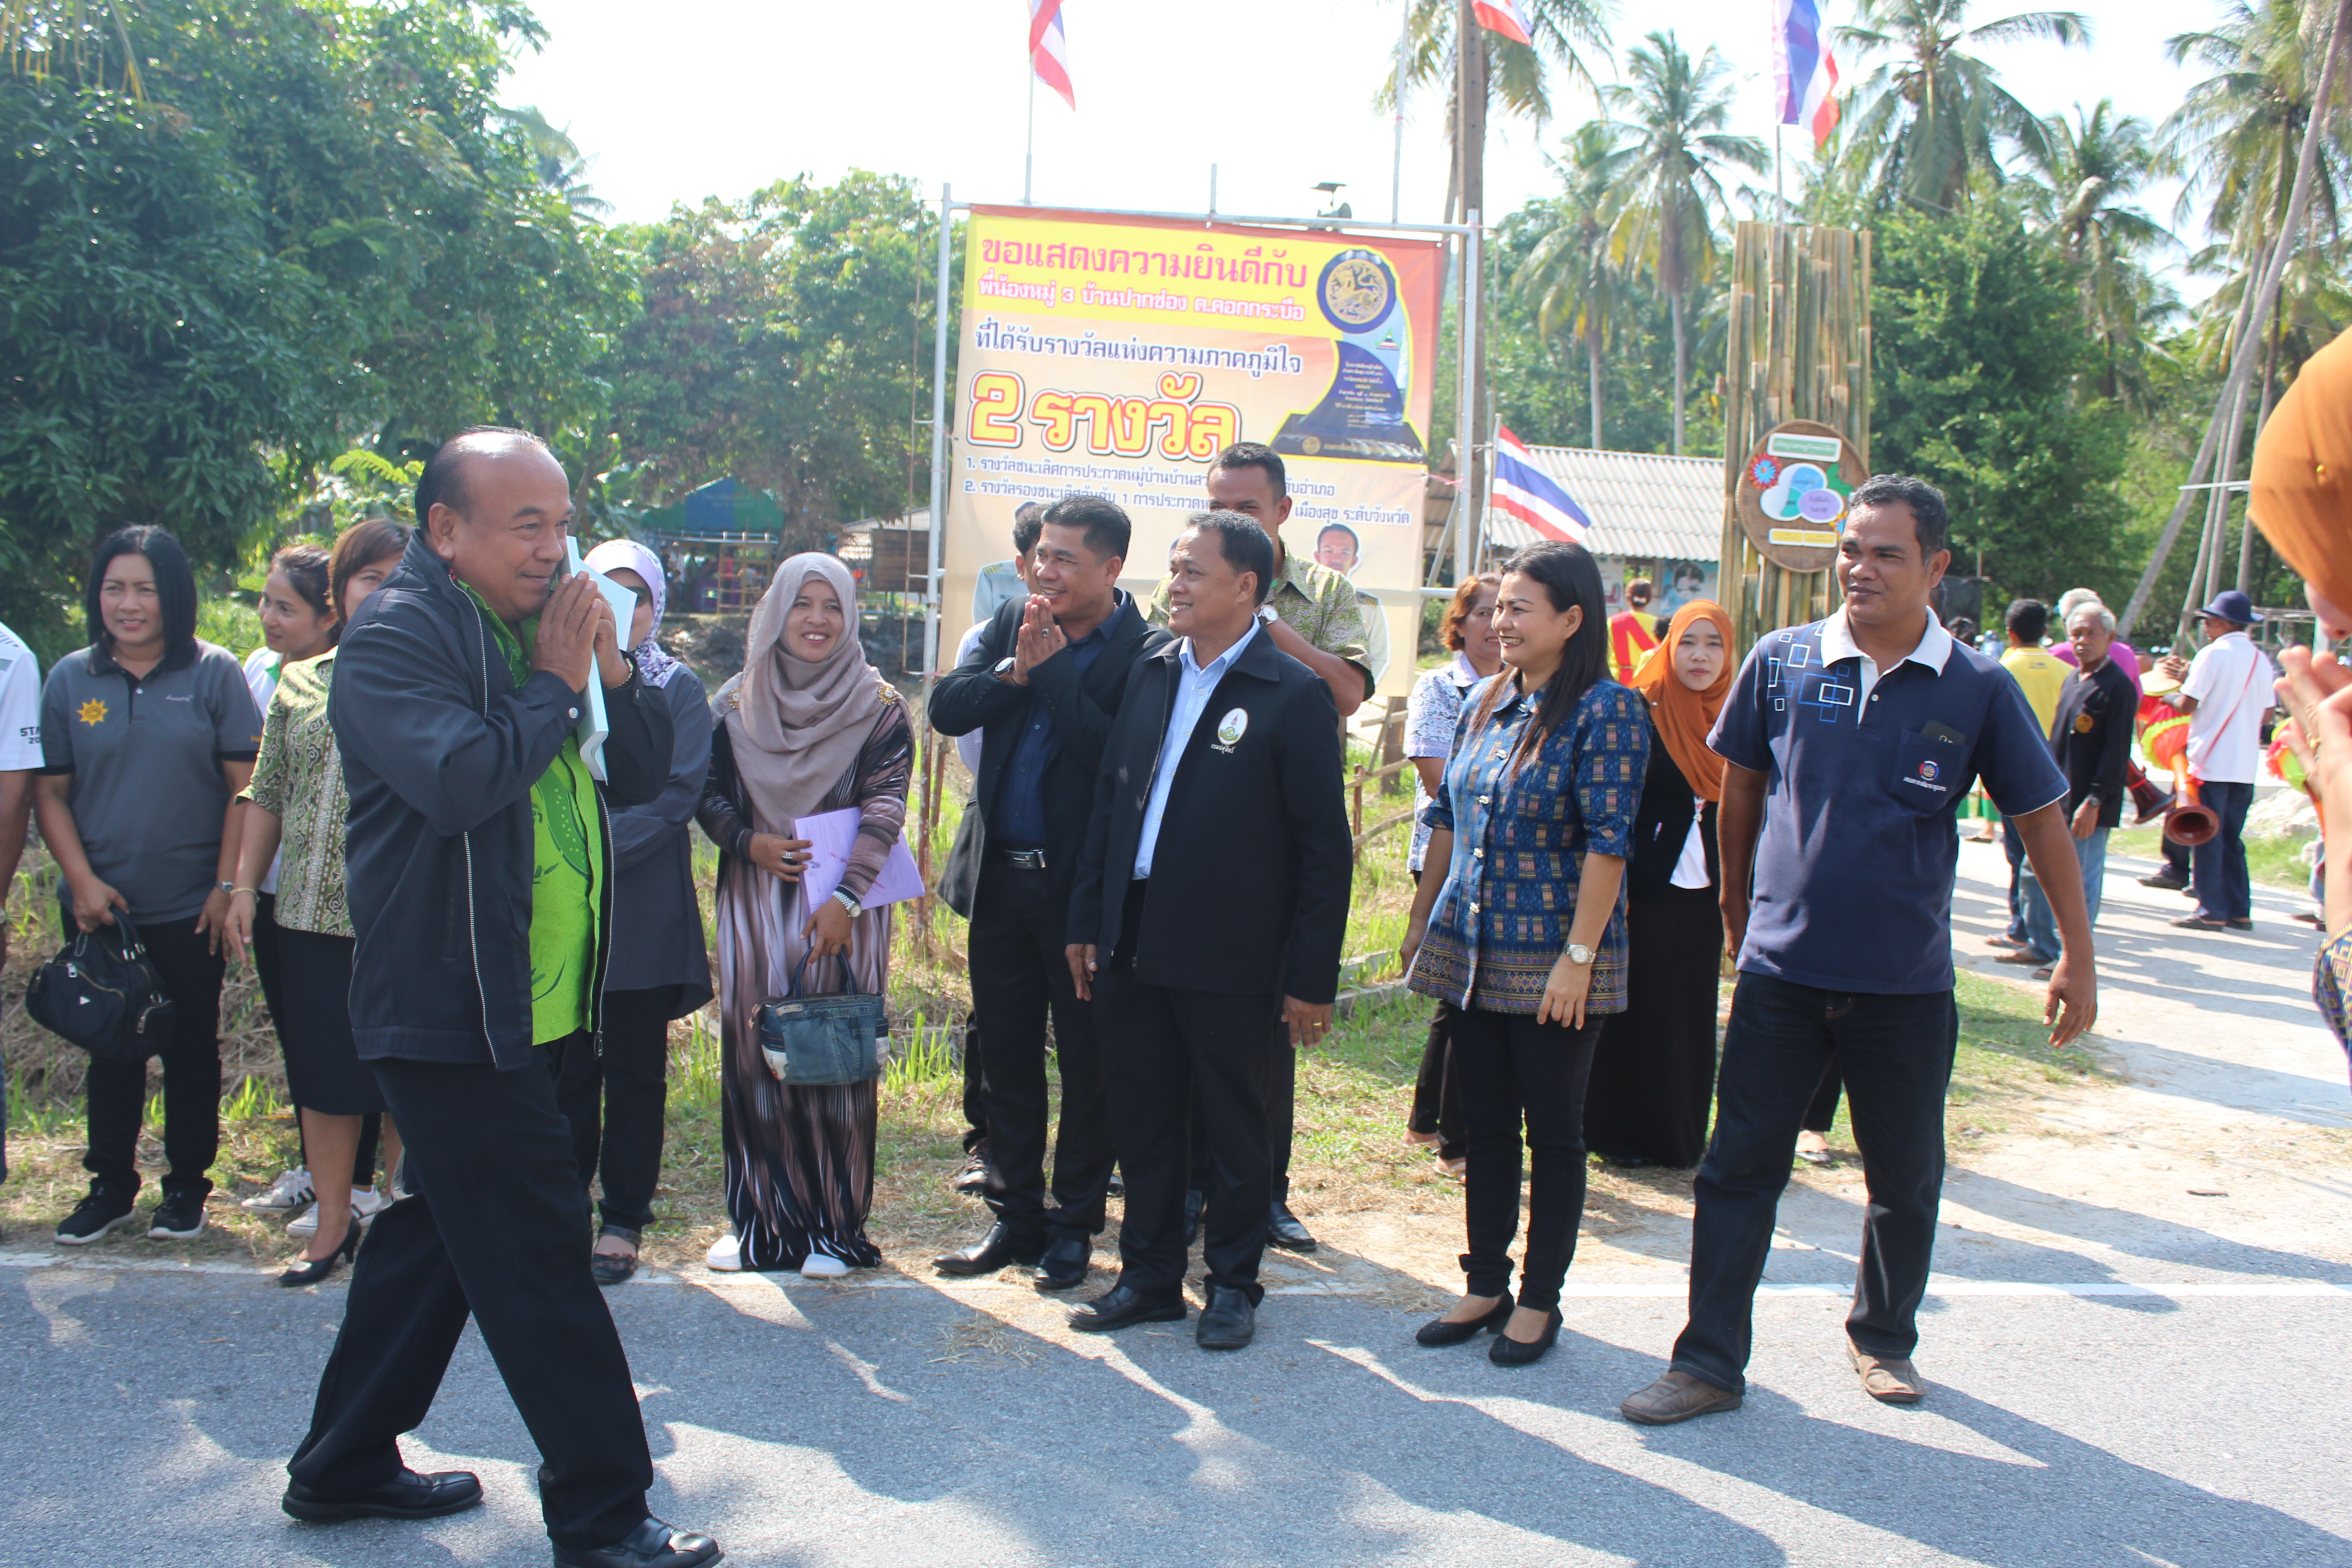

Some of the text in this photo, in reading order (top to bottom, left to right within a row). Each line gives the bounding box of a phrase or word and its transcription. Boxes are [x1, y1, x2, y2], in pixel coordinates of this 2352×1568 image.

[982, 239, 1307, 288] ขอแสดงความยินดีกับ
[978, 268, 1305, 321] พี่น้องหมู่ 3 บ้านปากช่อง ต.คอกกระบือ
[975, 317, 1301, 377] ที่ได้รับรางวัลแห่งความภาคภูมิใจ
[967, 370, 1241, 462] 2 รางวัล
[966, 457, 975, 469] 1.
[965, 480, 975, 492] 2.
[1122, 494, 1127, 504] 1
[1295, 500, 1338, 524] เมืองสุข
[1343, 505, 1409, 524] ระดับจังหวัด
